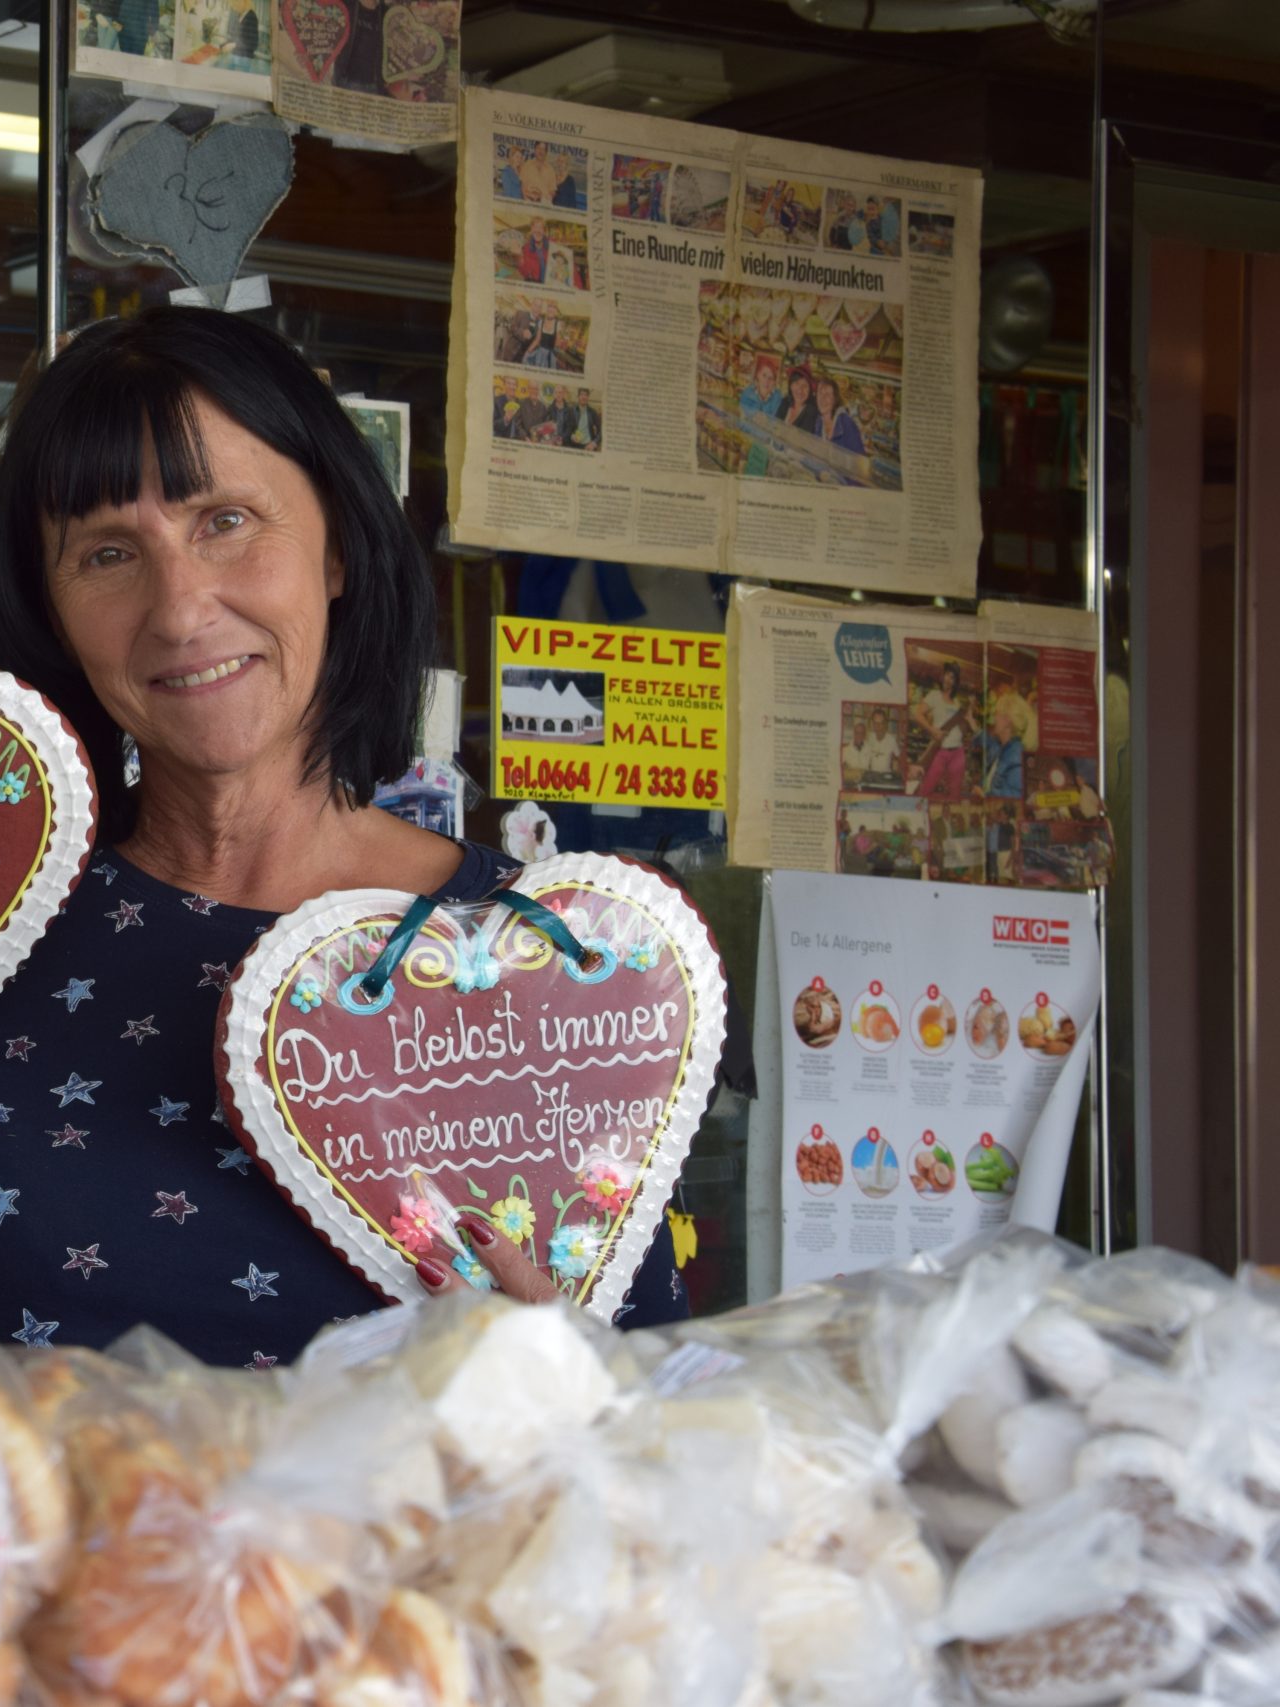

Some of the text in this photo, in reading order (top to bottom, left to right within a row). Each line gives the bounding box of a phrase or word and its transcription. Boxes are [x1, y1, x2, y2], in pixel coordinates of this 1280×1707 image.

[508, 112, 585, 135] VÖLKERMARKT
[612, 229, 885, 293] Eine Runde mit vielen Höhepunkten
[501, 624, 722, 669] VIP-ZELTE
[843, 650, 886, 669] LEUTE
[608, 677, 721, 700] FESTZELTE
[608, 694, 724, 711] IN ALLEN GRÖSSEN
[634, 711, 689, 724] TATJANA
[612, 722, 718, 750] MALLE
[501, 755, 591, 793] Tel.0664
[615, 763, 642, 795] 24
[648, 765, 687, 798] 333
[692, 768, 719, 800] 65
[791, 930, 893, 957] Die 14 Allergene
[994, 918, 1047, 942] WKO
[275, 990, 679, 1104] Du bleibst immer
[322, 1080, 669, 1174] in meinem Herzen
